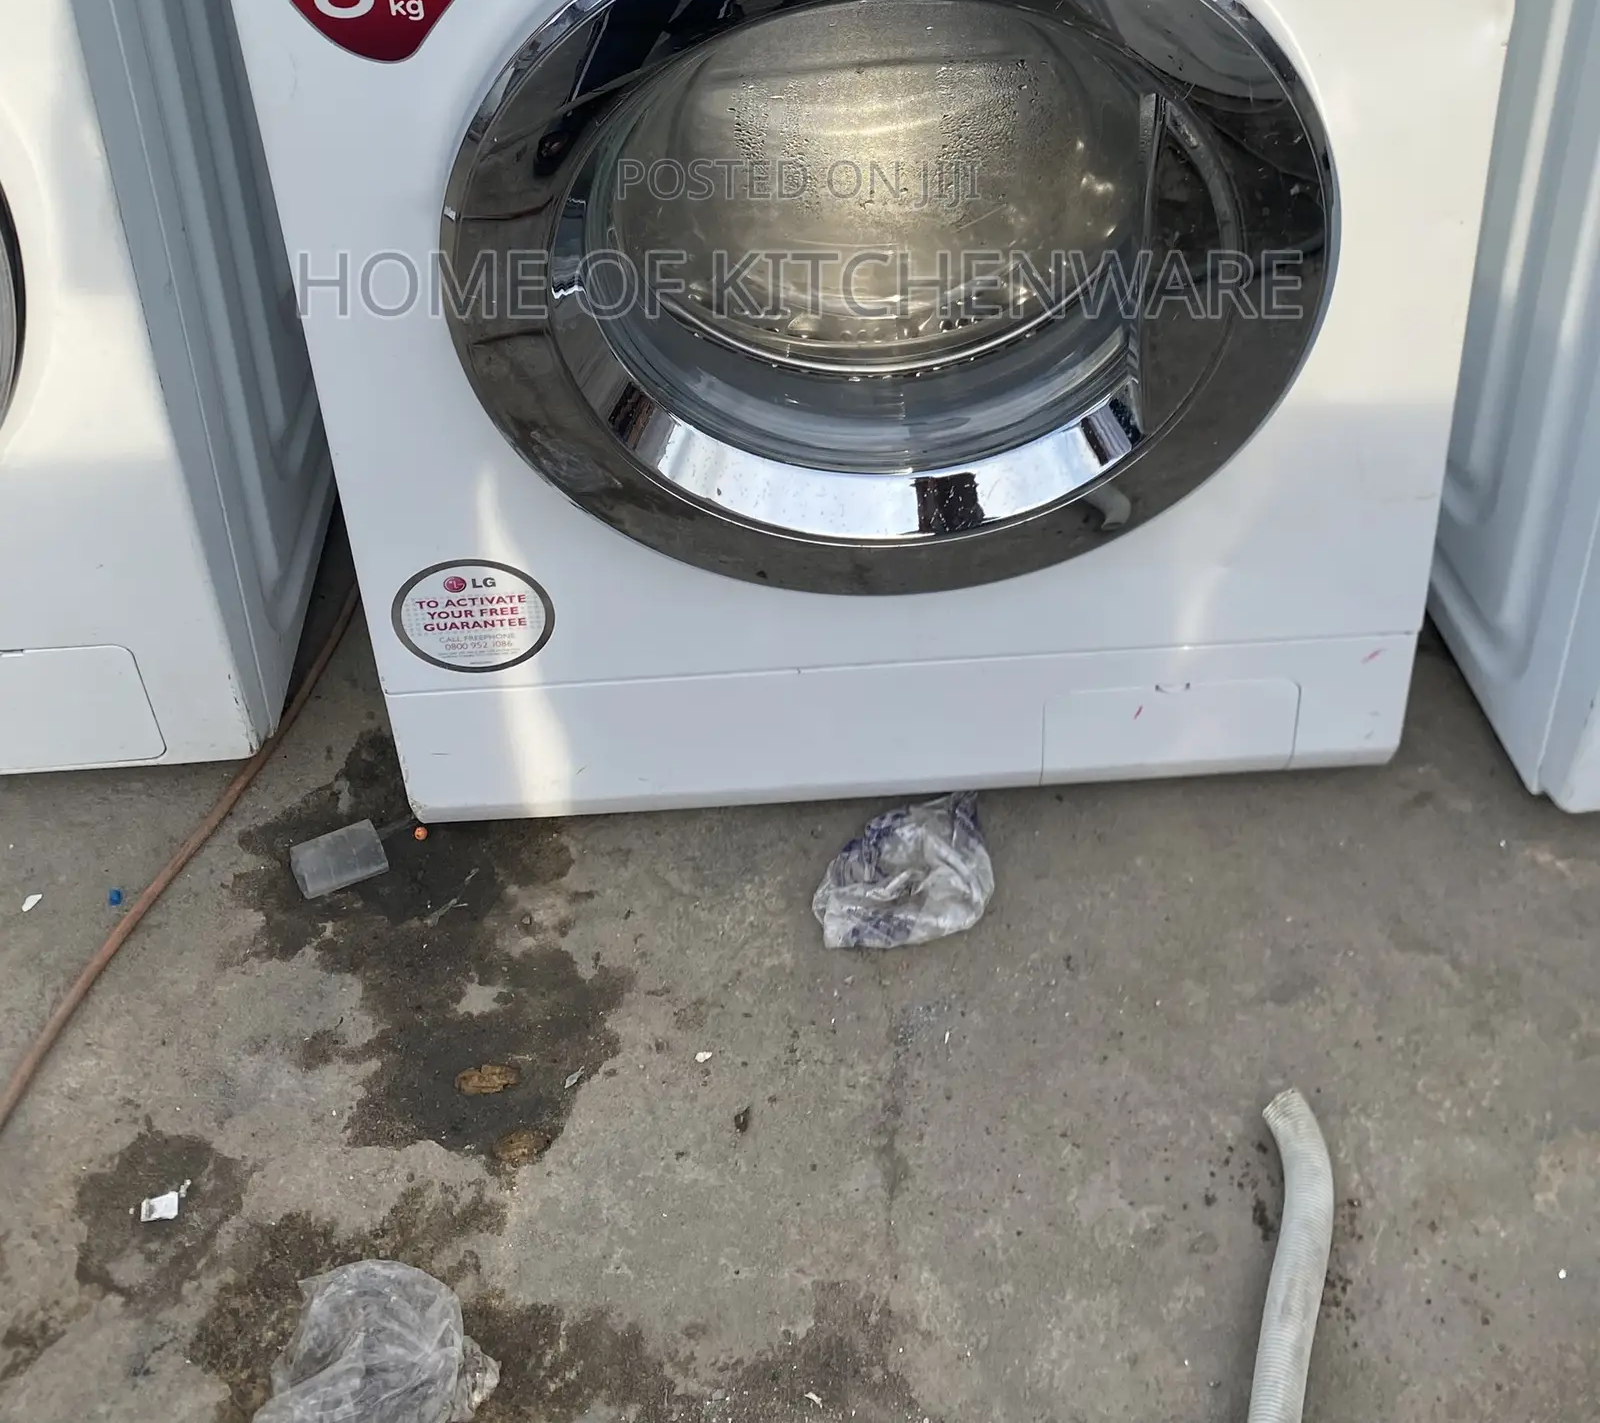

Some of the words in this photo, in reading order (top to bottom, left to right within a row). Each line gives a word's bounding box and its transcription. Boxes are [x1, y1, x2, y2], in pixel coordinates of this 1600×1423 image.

[471, 577, 497, 589] LG
[416, 600, 439, 610] TO
[444, 594, 527, 609] ACTIVATE
[427, 609, 474, 620] YOUR
[480, 606, 520, 617] FREE
[423, 618, 527, 632] GUARANTEE
[439, 635, 462, 643] CALL
[464, 633, 515, 641] FREEPHONE
[445, 642, 468, 651] 0800
[492, 640, 513, 648] 1086
